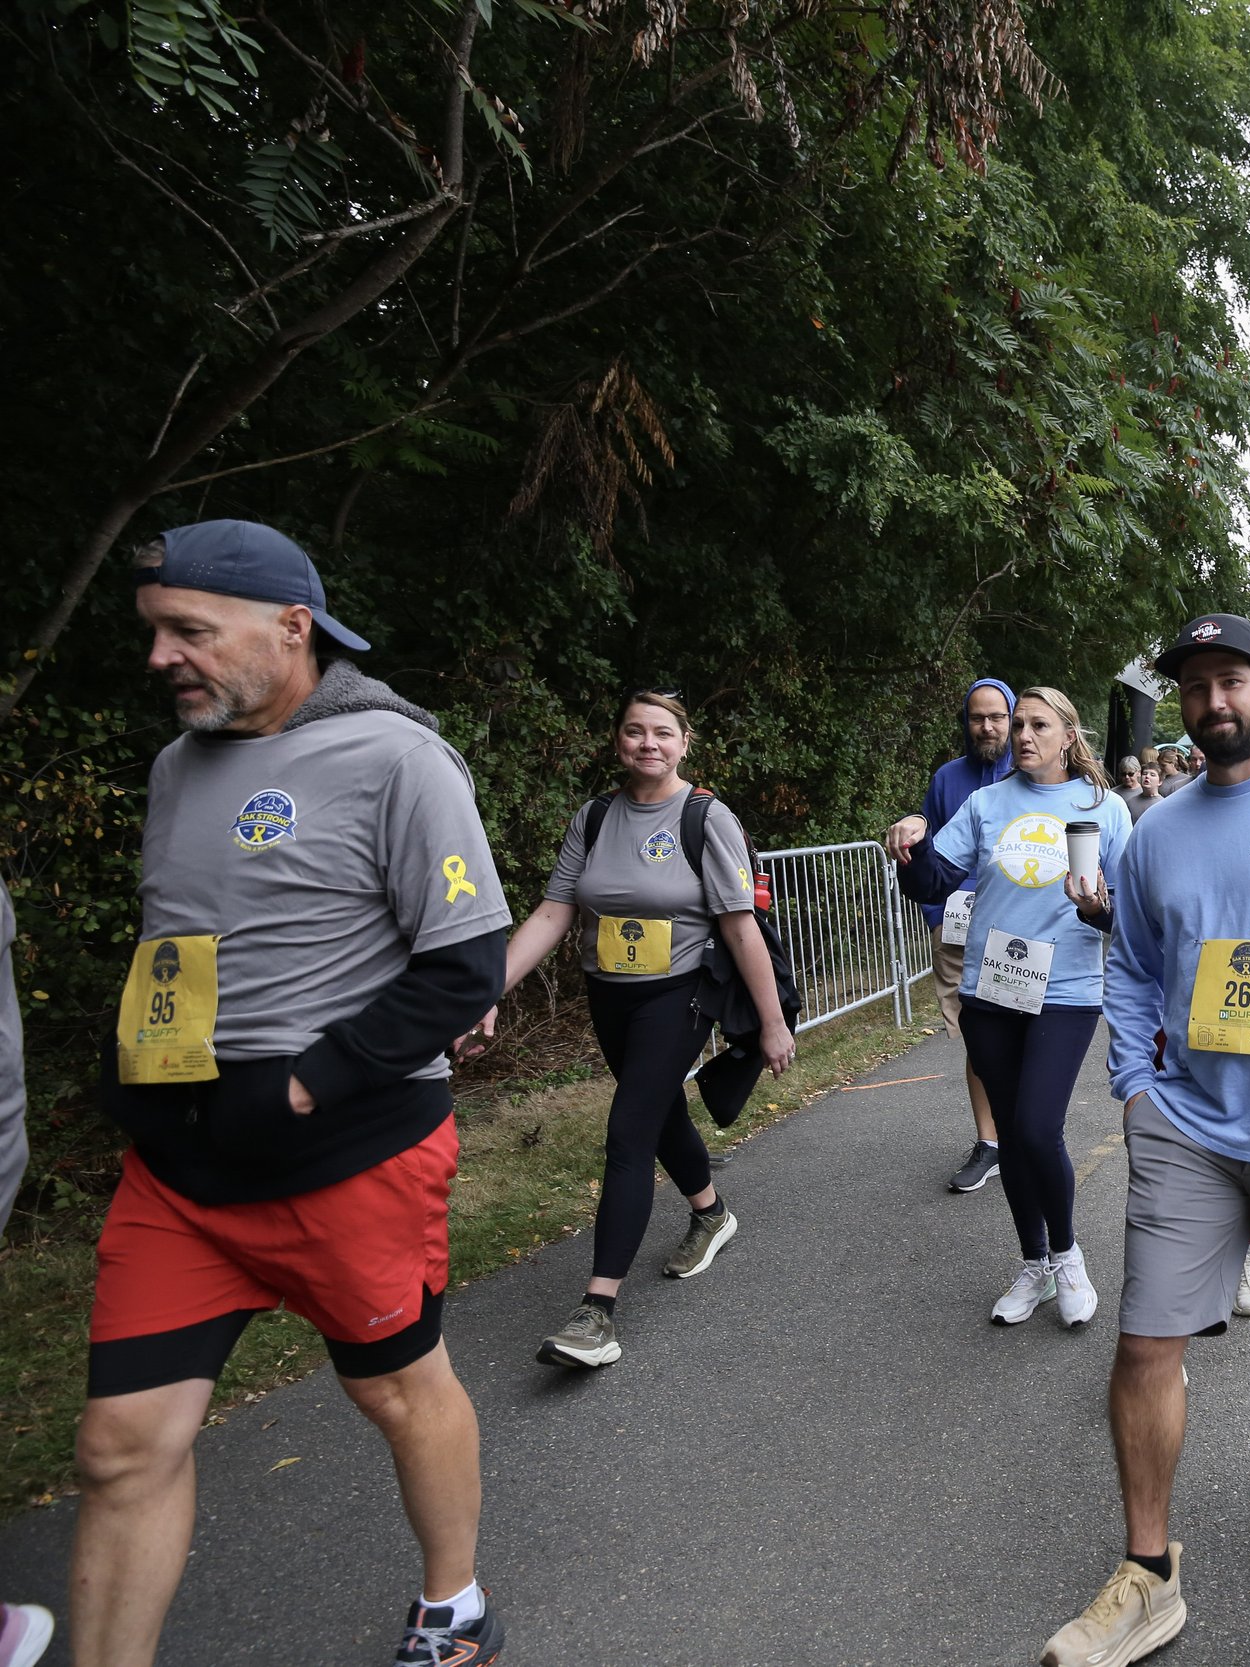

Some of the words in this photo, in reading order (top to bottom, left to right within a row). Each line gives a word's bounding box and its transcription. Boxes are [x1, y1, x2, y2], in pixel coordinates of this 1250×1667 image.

[239, 813, 255, 822] SAK
[256, 813, 291, 827] STRONG
[997, 842, 1022, 853] SAK
[944, 910, 961, 920] SAK
[627, 945, 636, 962] 9
[983, 956, 1002, 971] SAK
[1003, 963, 1048, 982] STRONG
[1001, 975, 1031, 988] DUFFY
[149, 991, 176, 1025] 95
[143, 1027, 182, 1039] DUFFY
